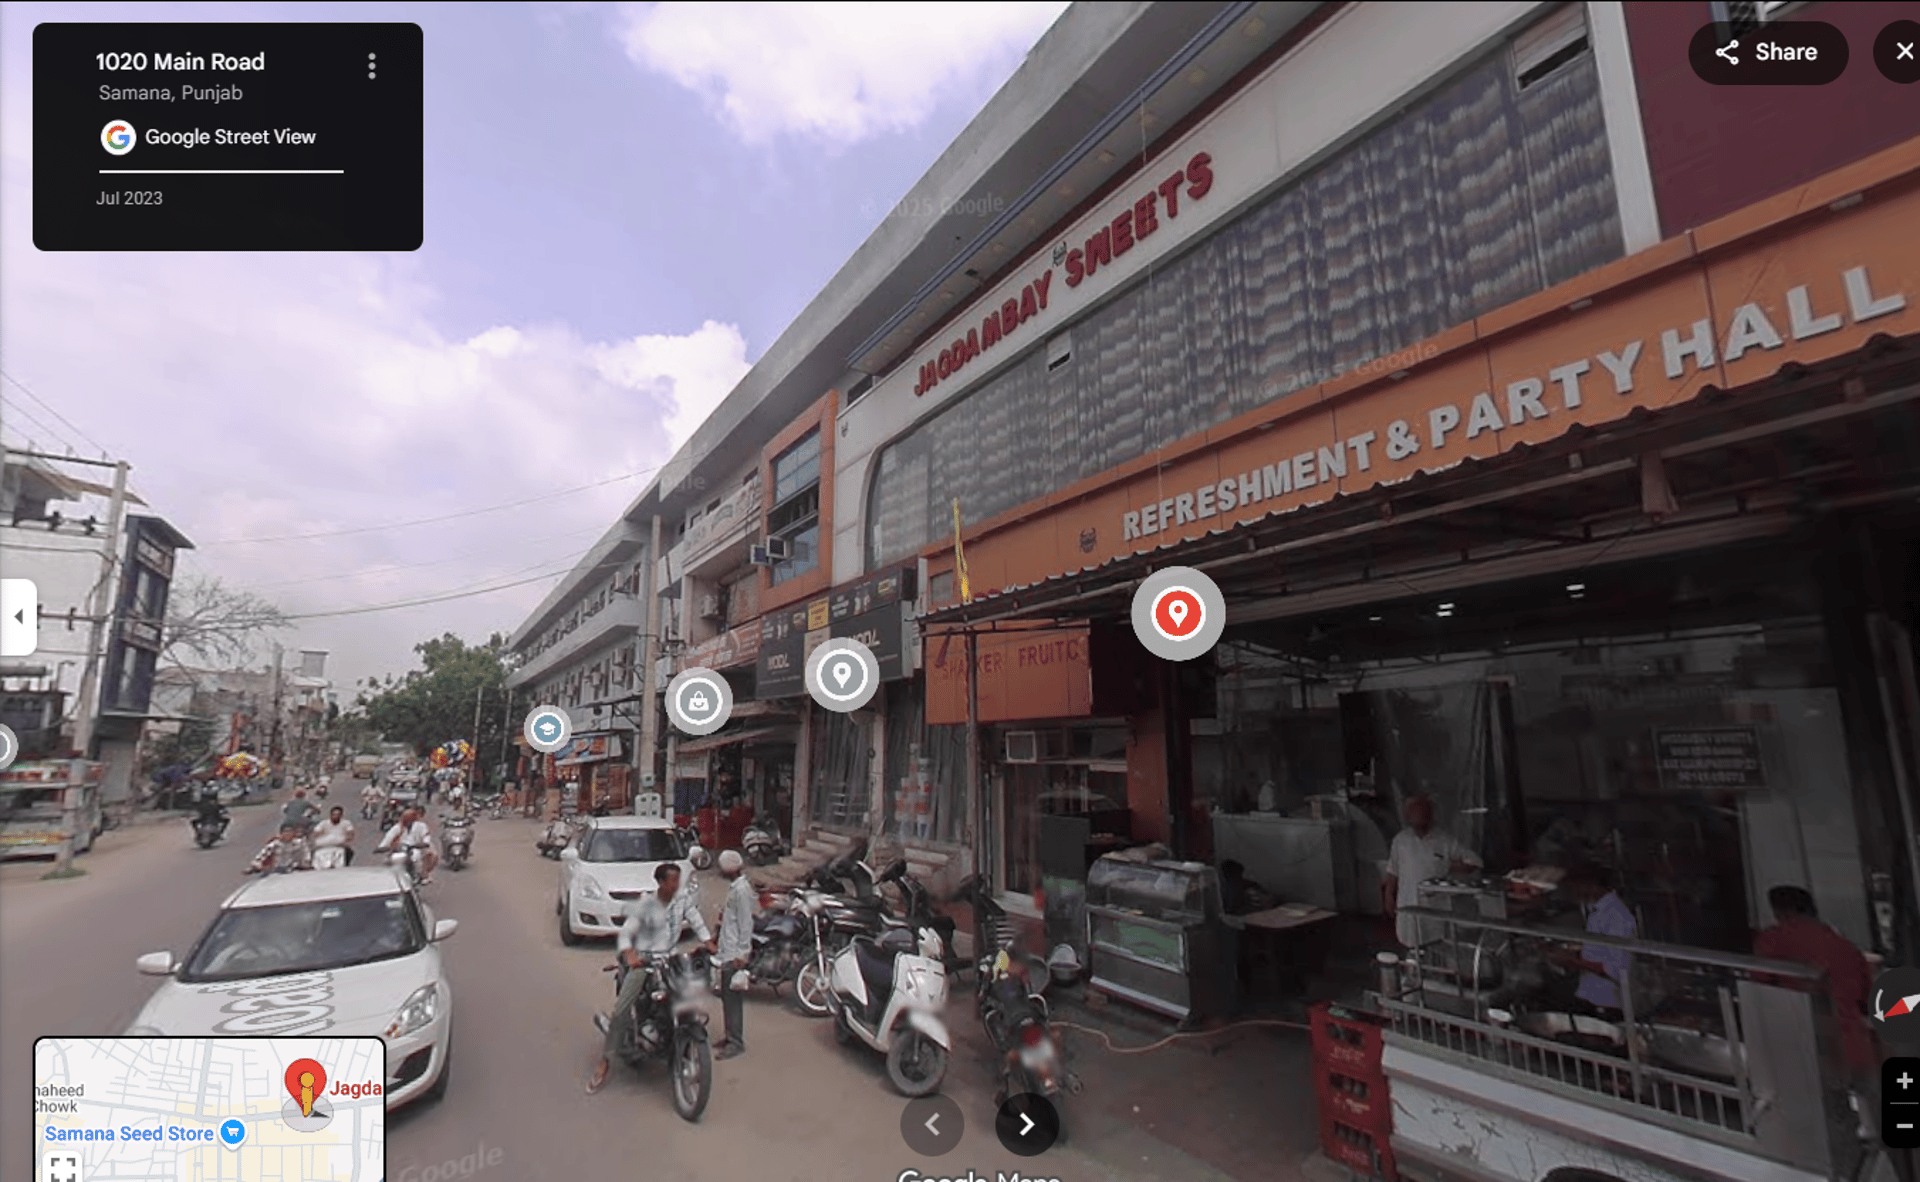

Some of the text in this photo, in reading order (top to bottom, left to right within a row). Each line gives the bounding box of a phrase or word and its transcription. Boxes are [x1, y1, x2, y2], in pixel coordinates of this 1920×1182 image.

[914, 151, 1213, 397] JAGDAMBAY SWEETS
[1123, 265, 1906, 542] REFRESHMENT & PARTY HALL
